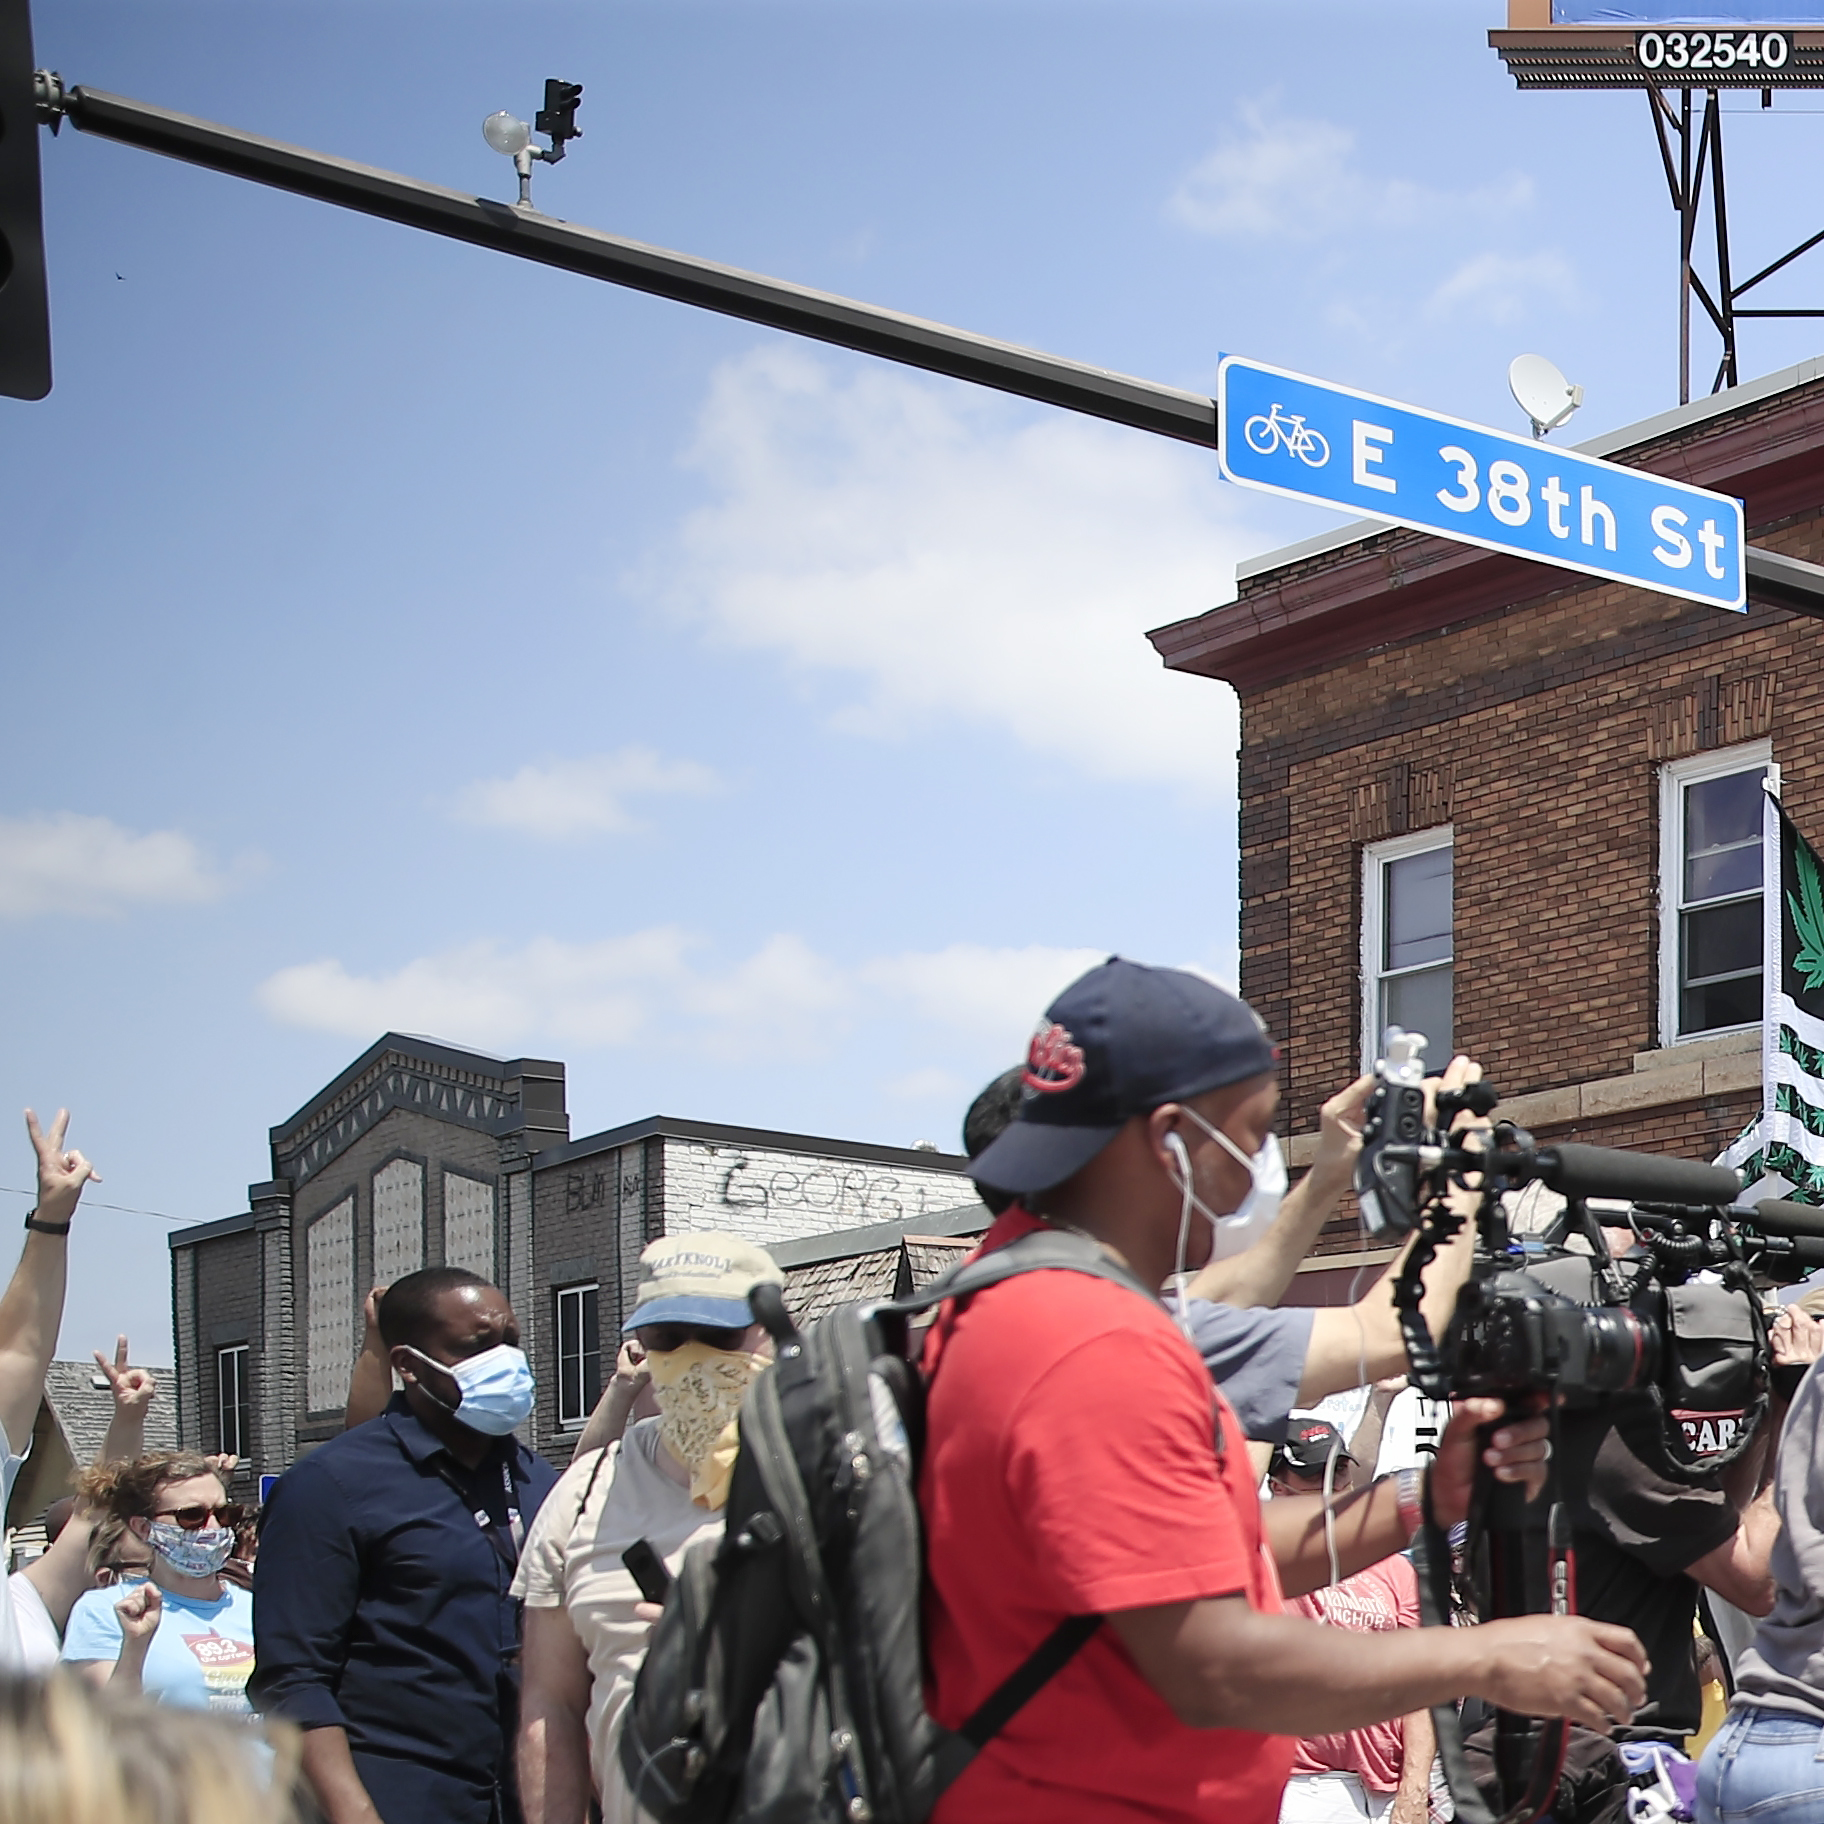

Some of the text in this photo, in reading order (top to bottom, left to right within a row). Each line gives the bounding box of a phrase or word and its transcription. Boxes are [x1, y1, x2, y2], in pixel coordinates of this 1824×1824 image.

[1639, 32, 1788, 68] 032540
[1352, 419, 1726, 579] E 38th St
